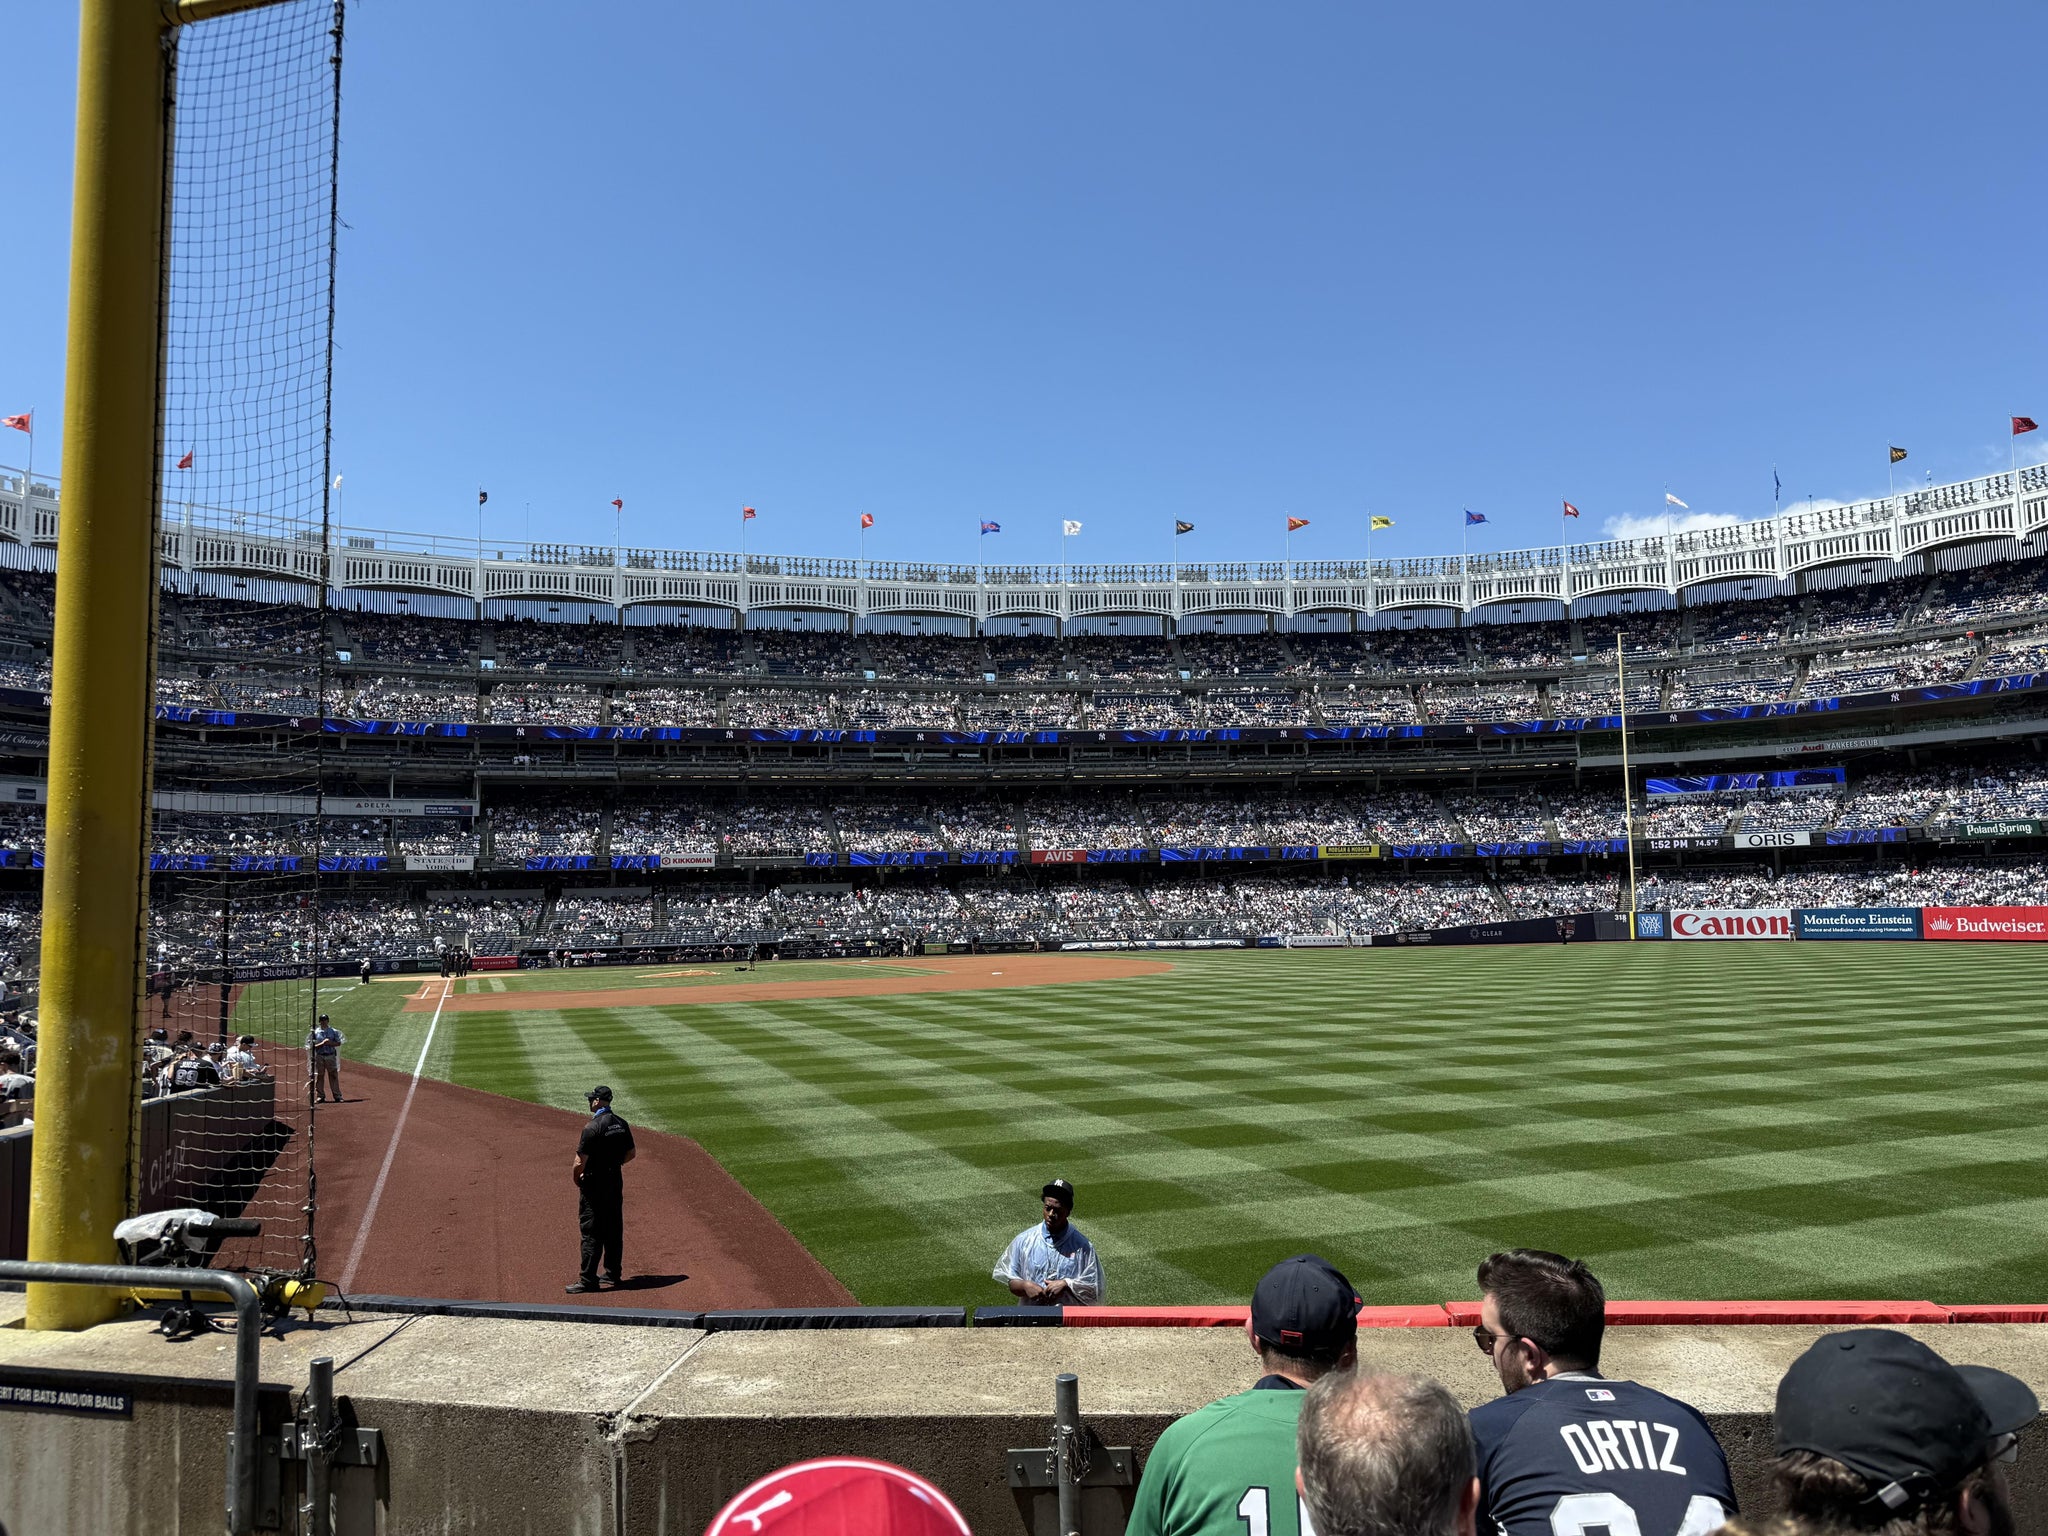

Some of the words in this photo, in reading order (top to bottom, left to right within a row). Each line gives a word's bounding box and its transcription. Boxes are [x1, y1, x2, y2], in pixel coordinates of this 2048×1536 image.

[1216, 696, 1247, 704] ASPEN
[1258, 695, 1289, 703] VODKA
[1801, 744, 1824, 752] Audi
[1827, 740, 1858, 750] YANKEES
[1860, 739, 1878, 747] CLUB
[1966, 824, 1998, 836] Poland
[1998, 823, 2032, 834] Spring
[1651, 840, 1670, 849] 1:52
[1673, 840, 1688, 849] PM
[1749, 834, 1795, 847] ORIS
[1045, 851, 1073, 861] AVIS
[1639, 921, 1661, 929] YORK
[1673, 913, 1789, 936] Canon
[1804, 914, 1866, 925] Montefiore
[1869, 914, 1912, 924] Einstein
[263, 968, 297, 977] StubHub
[175, 1069, 198, 1086] 99
[151, 1139, 185, 1195] CLEAR
[14, 1388, 32, 1401] FOR
[33, 1389, 57, 1404] BATS
[58, 1391, 93, 1408] AND/OR
[95, 1395, 124, 1410] BALLS
[1560, 1420, 1687, 1476] ORTIZ
